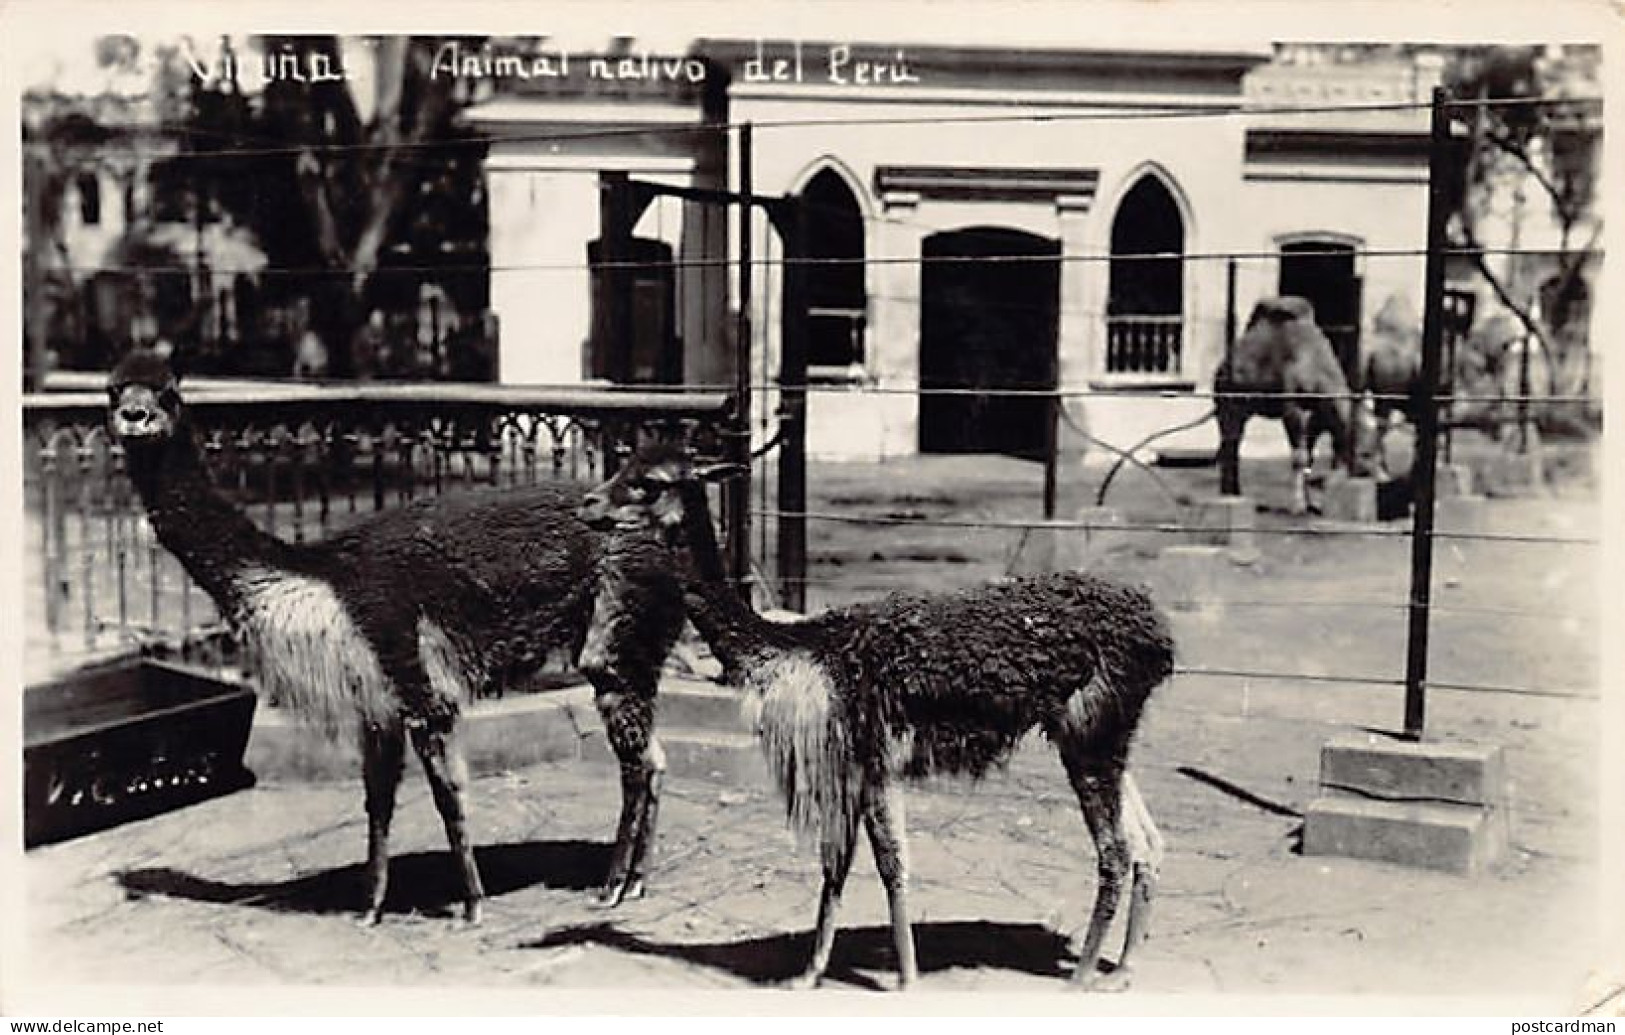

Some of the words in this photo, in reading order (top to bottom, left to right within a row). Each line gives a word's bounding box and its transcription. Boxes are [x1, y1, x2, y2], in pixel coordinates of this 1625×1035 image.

[431, 40, 568, 80] Animal
[590, 52, 706, 83] nativo
[745, 40, 803, 82] del
[828, 46, 920, 83] Perú
